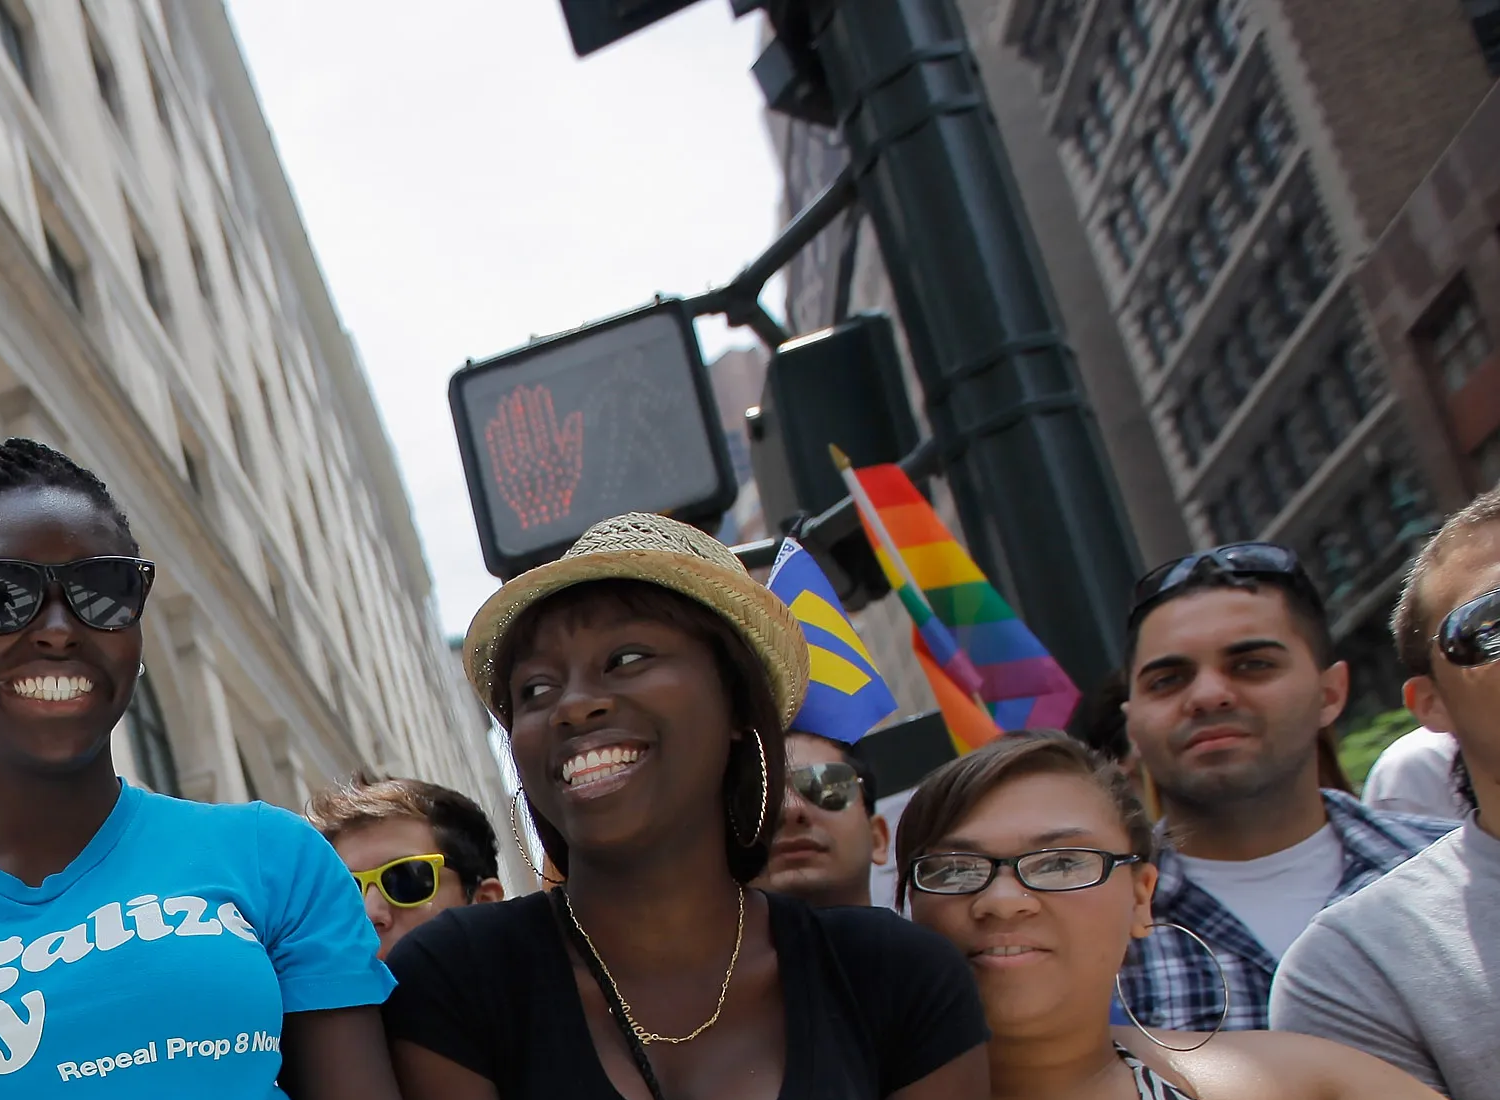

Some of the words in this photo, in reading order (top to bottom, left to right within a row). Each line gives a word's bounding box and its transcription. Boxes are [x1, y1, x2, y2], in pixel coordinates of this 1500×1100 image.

[56, 1042, 156, 1082] Repeal
[167, 1037, 230, 1060] Prop
[234, 1032, 249, 1054] 8
